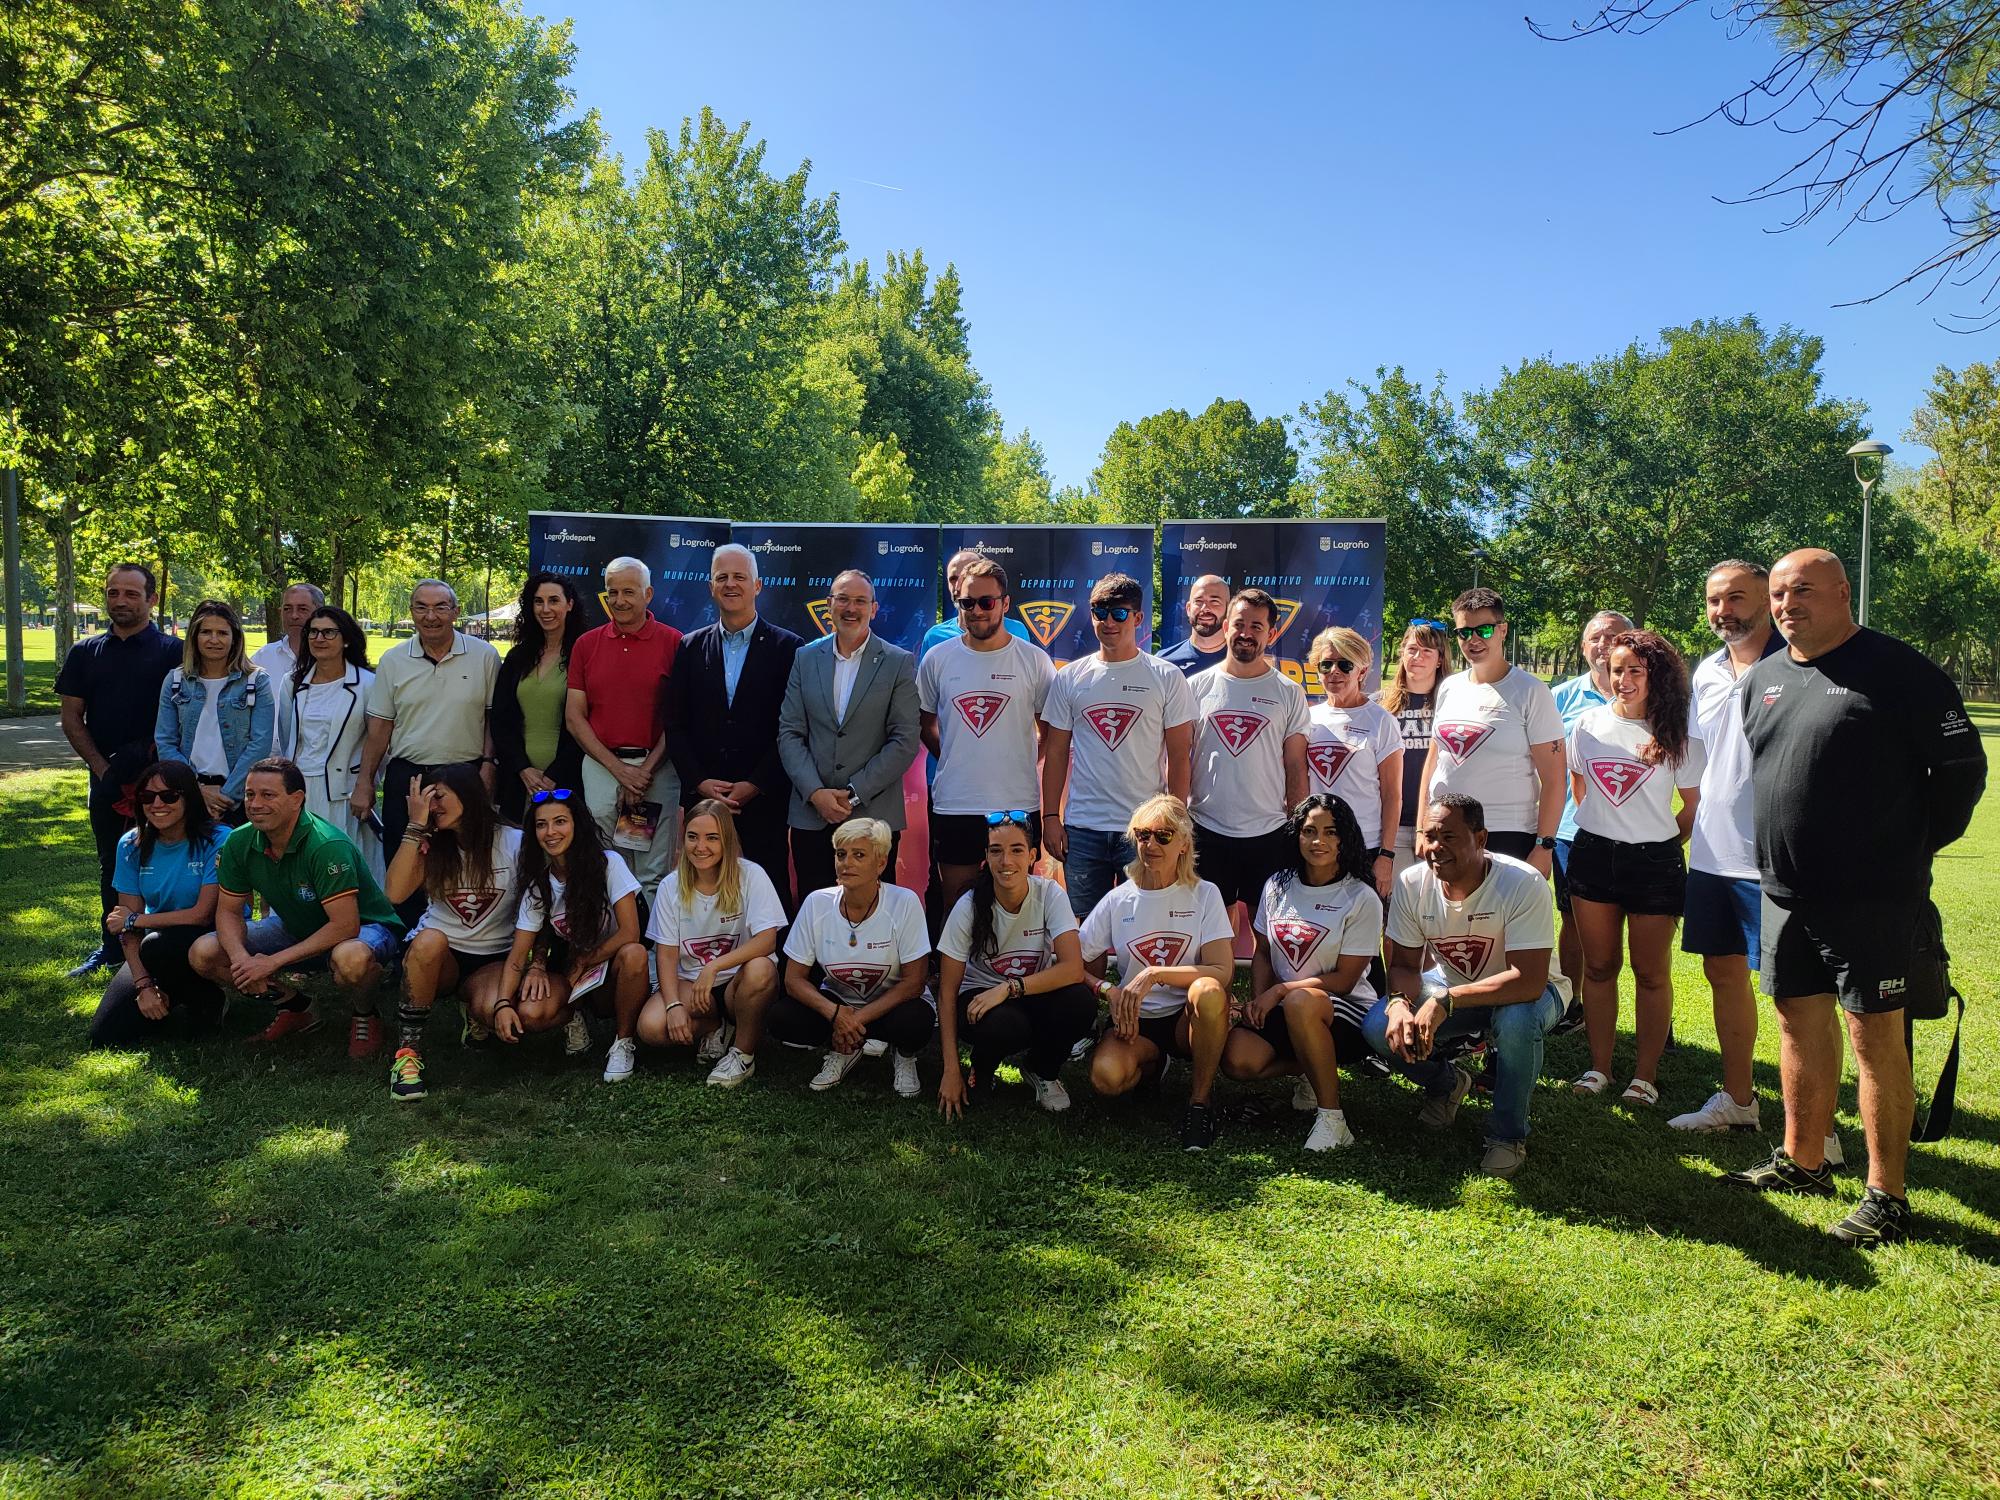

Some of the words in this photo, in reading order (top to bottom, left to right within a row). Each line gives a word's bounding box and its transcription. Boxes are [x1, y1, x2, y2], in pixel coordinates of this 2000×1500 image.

[682, 537, 716, 548] Logroño
[1332, 540, 1370, 550] Logroño
[890, 544, 924, 554] Logroño
[1104, 544, 1139, 554] Logroño
[663, 570, 711, 582] MUNICIPA
[1244, 576, 1302, 586] DEPORTIVO
[1314, 576, 1371, 586] MUNICIPAL
[872, 577, 925, 588] MUNICIPAL
[1020, 579, 1075, 589] DEPORTIVO
[1878, 977, 1905, 990] BH
